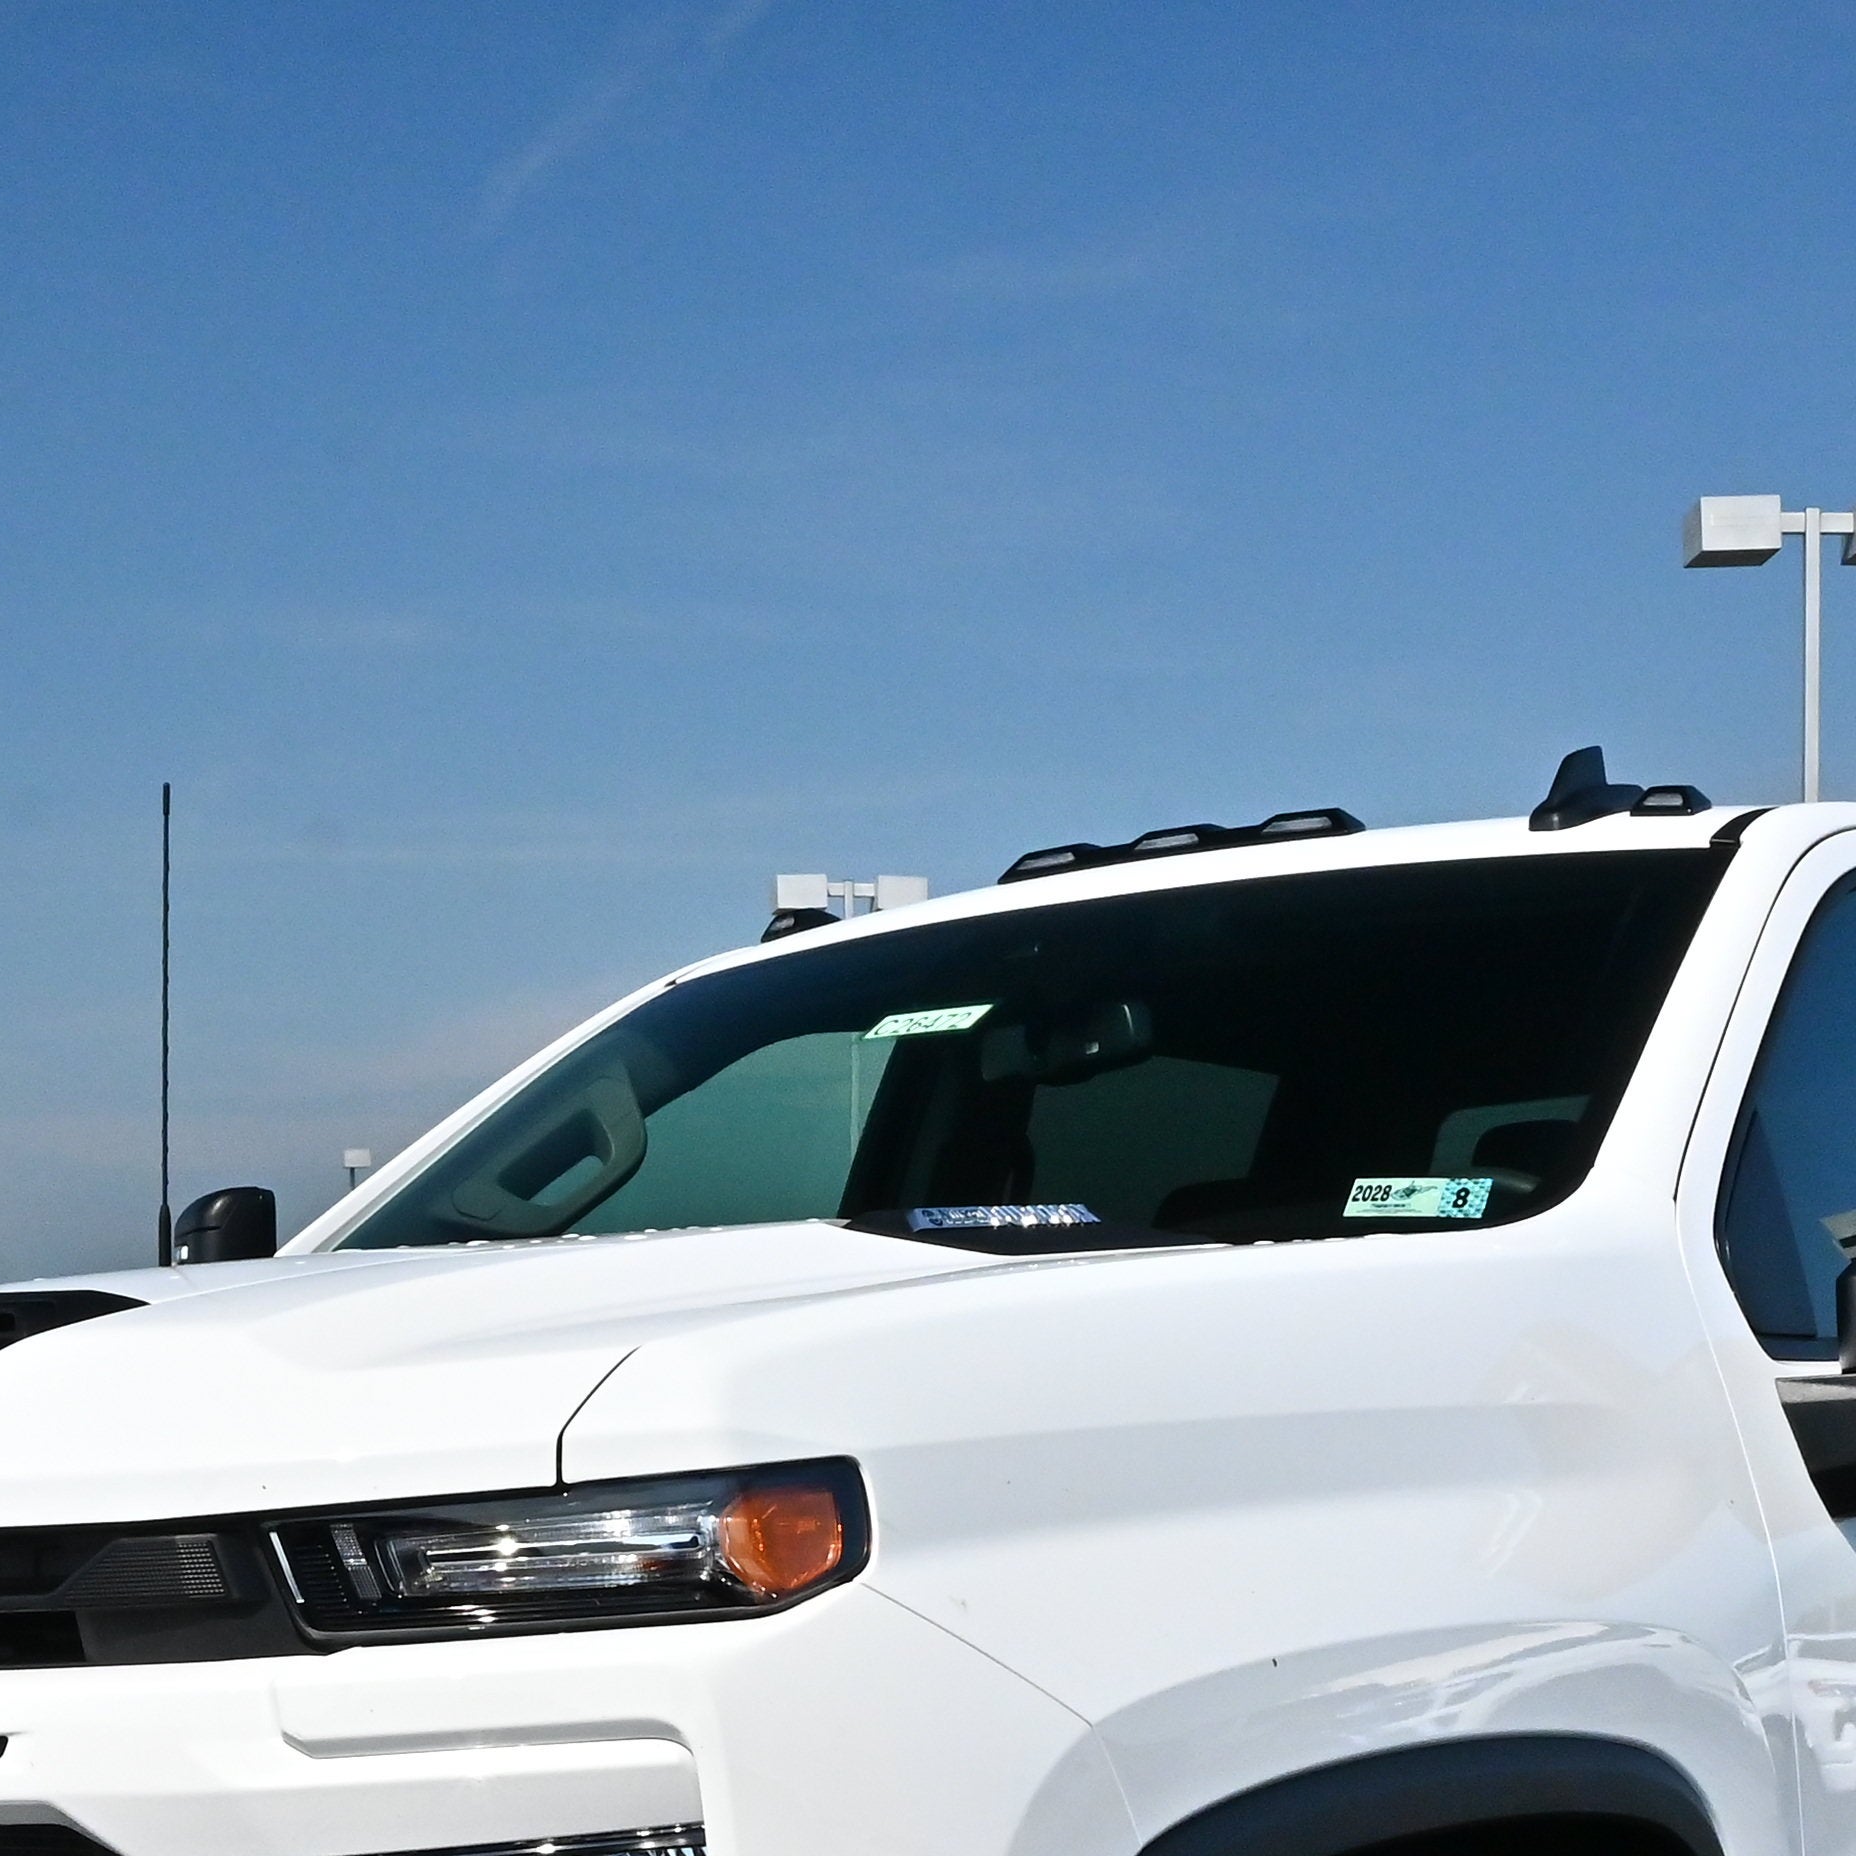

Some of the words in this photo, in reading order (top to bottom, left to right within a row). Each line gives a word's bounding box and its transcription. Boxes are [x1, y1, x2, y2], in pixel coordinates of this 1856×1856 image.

[873, 1011, 972, 1036] C26472
[1351, 1184, 1393, 1203] 2028
[1451, 1187, 1471, 1209] 8
